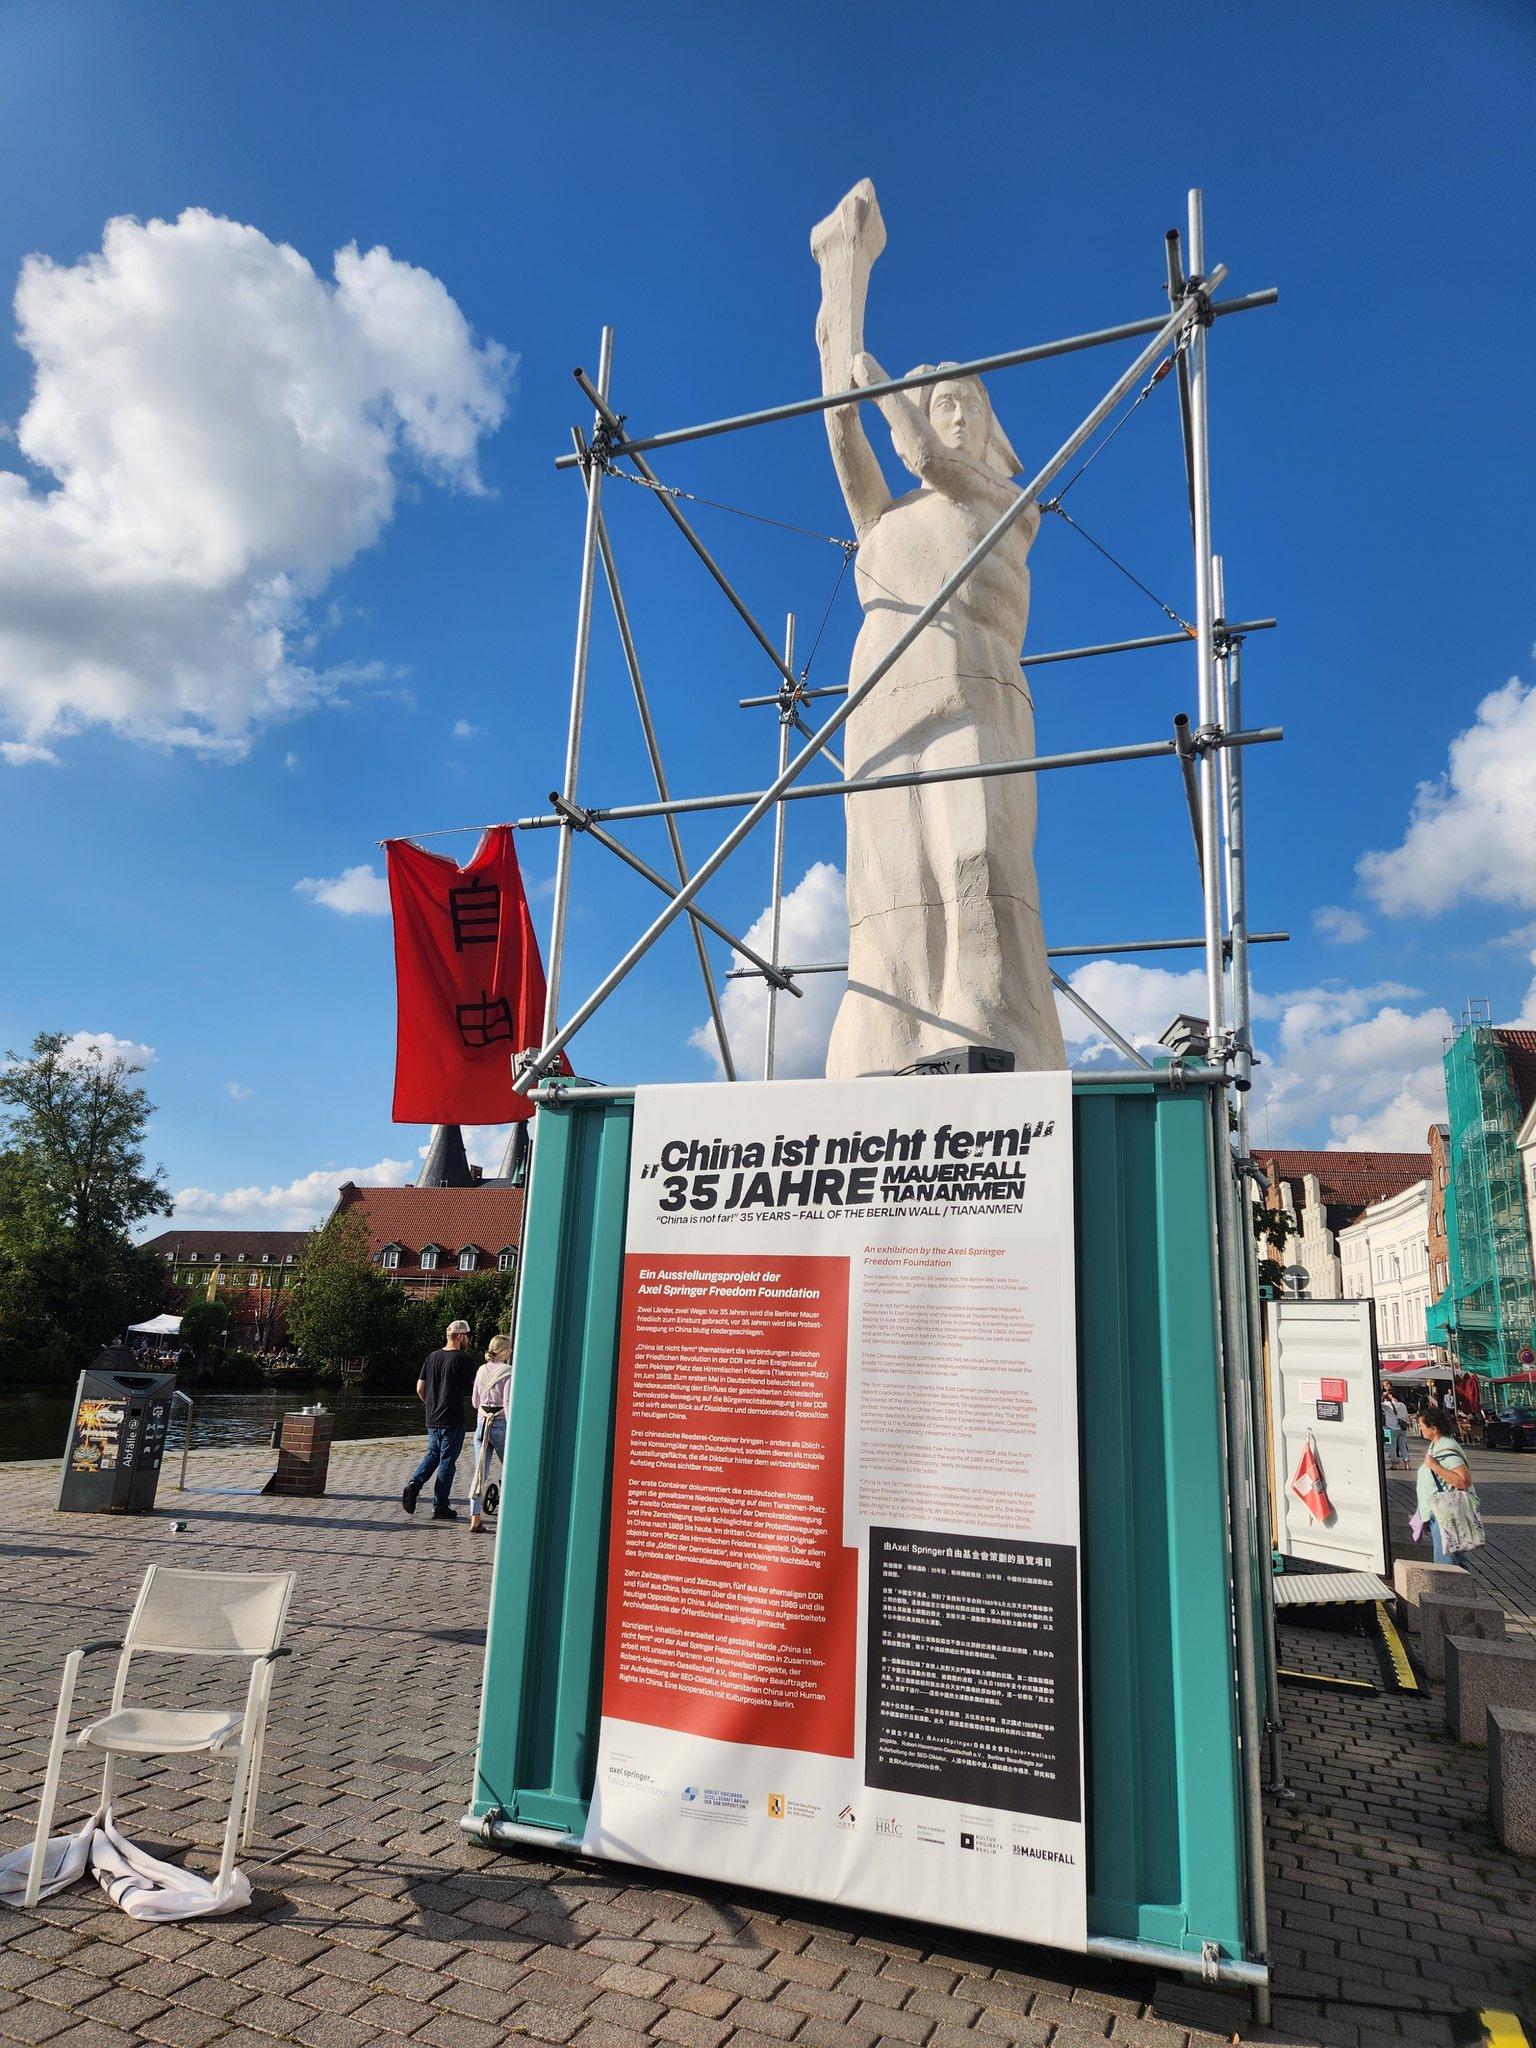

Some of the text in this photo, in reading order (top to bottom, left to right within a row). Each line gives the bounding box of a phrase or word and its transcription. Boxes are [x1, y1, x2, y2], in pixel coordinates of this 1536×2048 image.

[772, 1134, 820, 1167] ist
[825, 1128, 927, 1164] nicht
[882, 1161, 1026, 1184] MAUERFALL
[659, 1167, 878, 1212] 35 JAHRE
[880, 1181, 1026, 1203] TIANANMEN
[690, 1214, 697, 1224] is
[699, 1214, 716, 1223] not
[740, 1212, 754, 1222] 35
[756, 1211, 790, 1221] YEARS
[800, 1210, 826, 1220] FALL
[827, 1209, 842, 1219] OF
[845, 1208, 864, 1218] THE
[866, 1207, 906, 1217] BERLIN
[909, 1206, 941, 1217] WALL
[951, 1204, 1023, 1215] TIANANMEN
[877, 1246, 918, 1254] exhibition
[920, 1247, 930, 1256] by
[932, 1247, 946, 1255] the
[948, 1247, 967, 1255] Axel
[968, 1248, 1006, 1257] Springer
[864, 1257, 951, 1267] Freedom Foundation
[639, 1269, 781, 1283] Ein Ausstellungsprojekt der
[638, 1284, 821, 1298] Axel Springer Freedom Foundation
[122, 1431, 138, 1468] Abfälle
[609, 1766, 623, 1775] axel
[608, 1775, 671, 1797] freedom foundation
[1021, 1846, 1076, 1865] MAUERFALL
